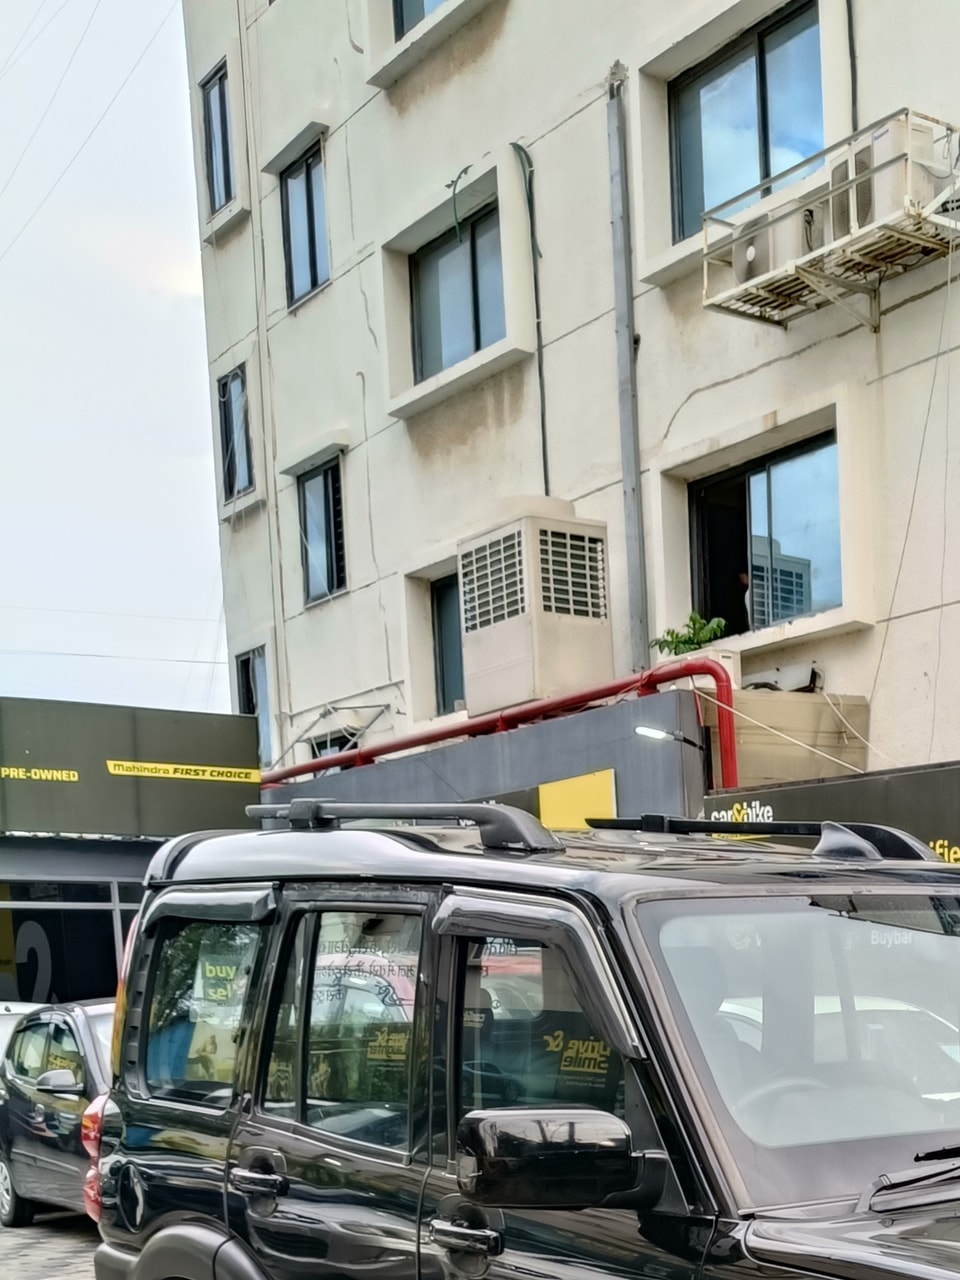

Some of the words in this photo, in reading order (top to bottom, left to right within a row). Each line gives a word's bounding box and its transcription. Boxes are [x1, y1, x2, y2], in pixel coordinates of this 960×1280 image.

[1, 767, 79, 782] PRE-OWNED
[113, 763, 170, 775] Mahindra
[172, 767, 207, 777] FIRST
[209, 769, 253, 780] CHOICE
[205, 961, 237, 980] buy
